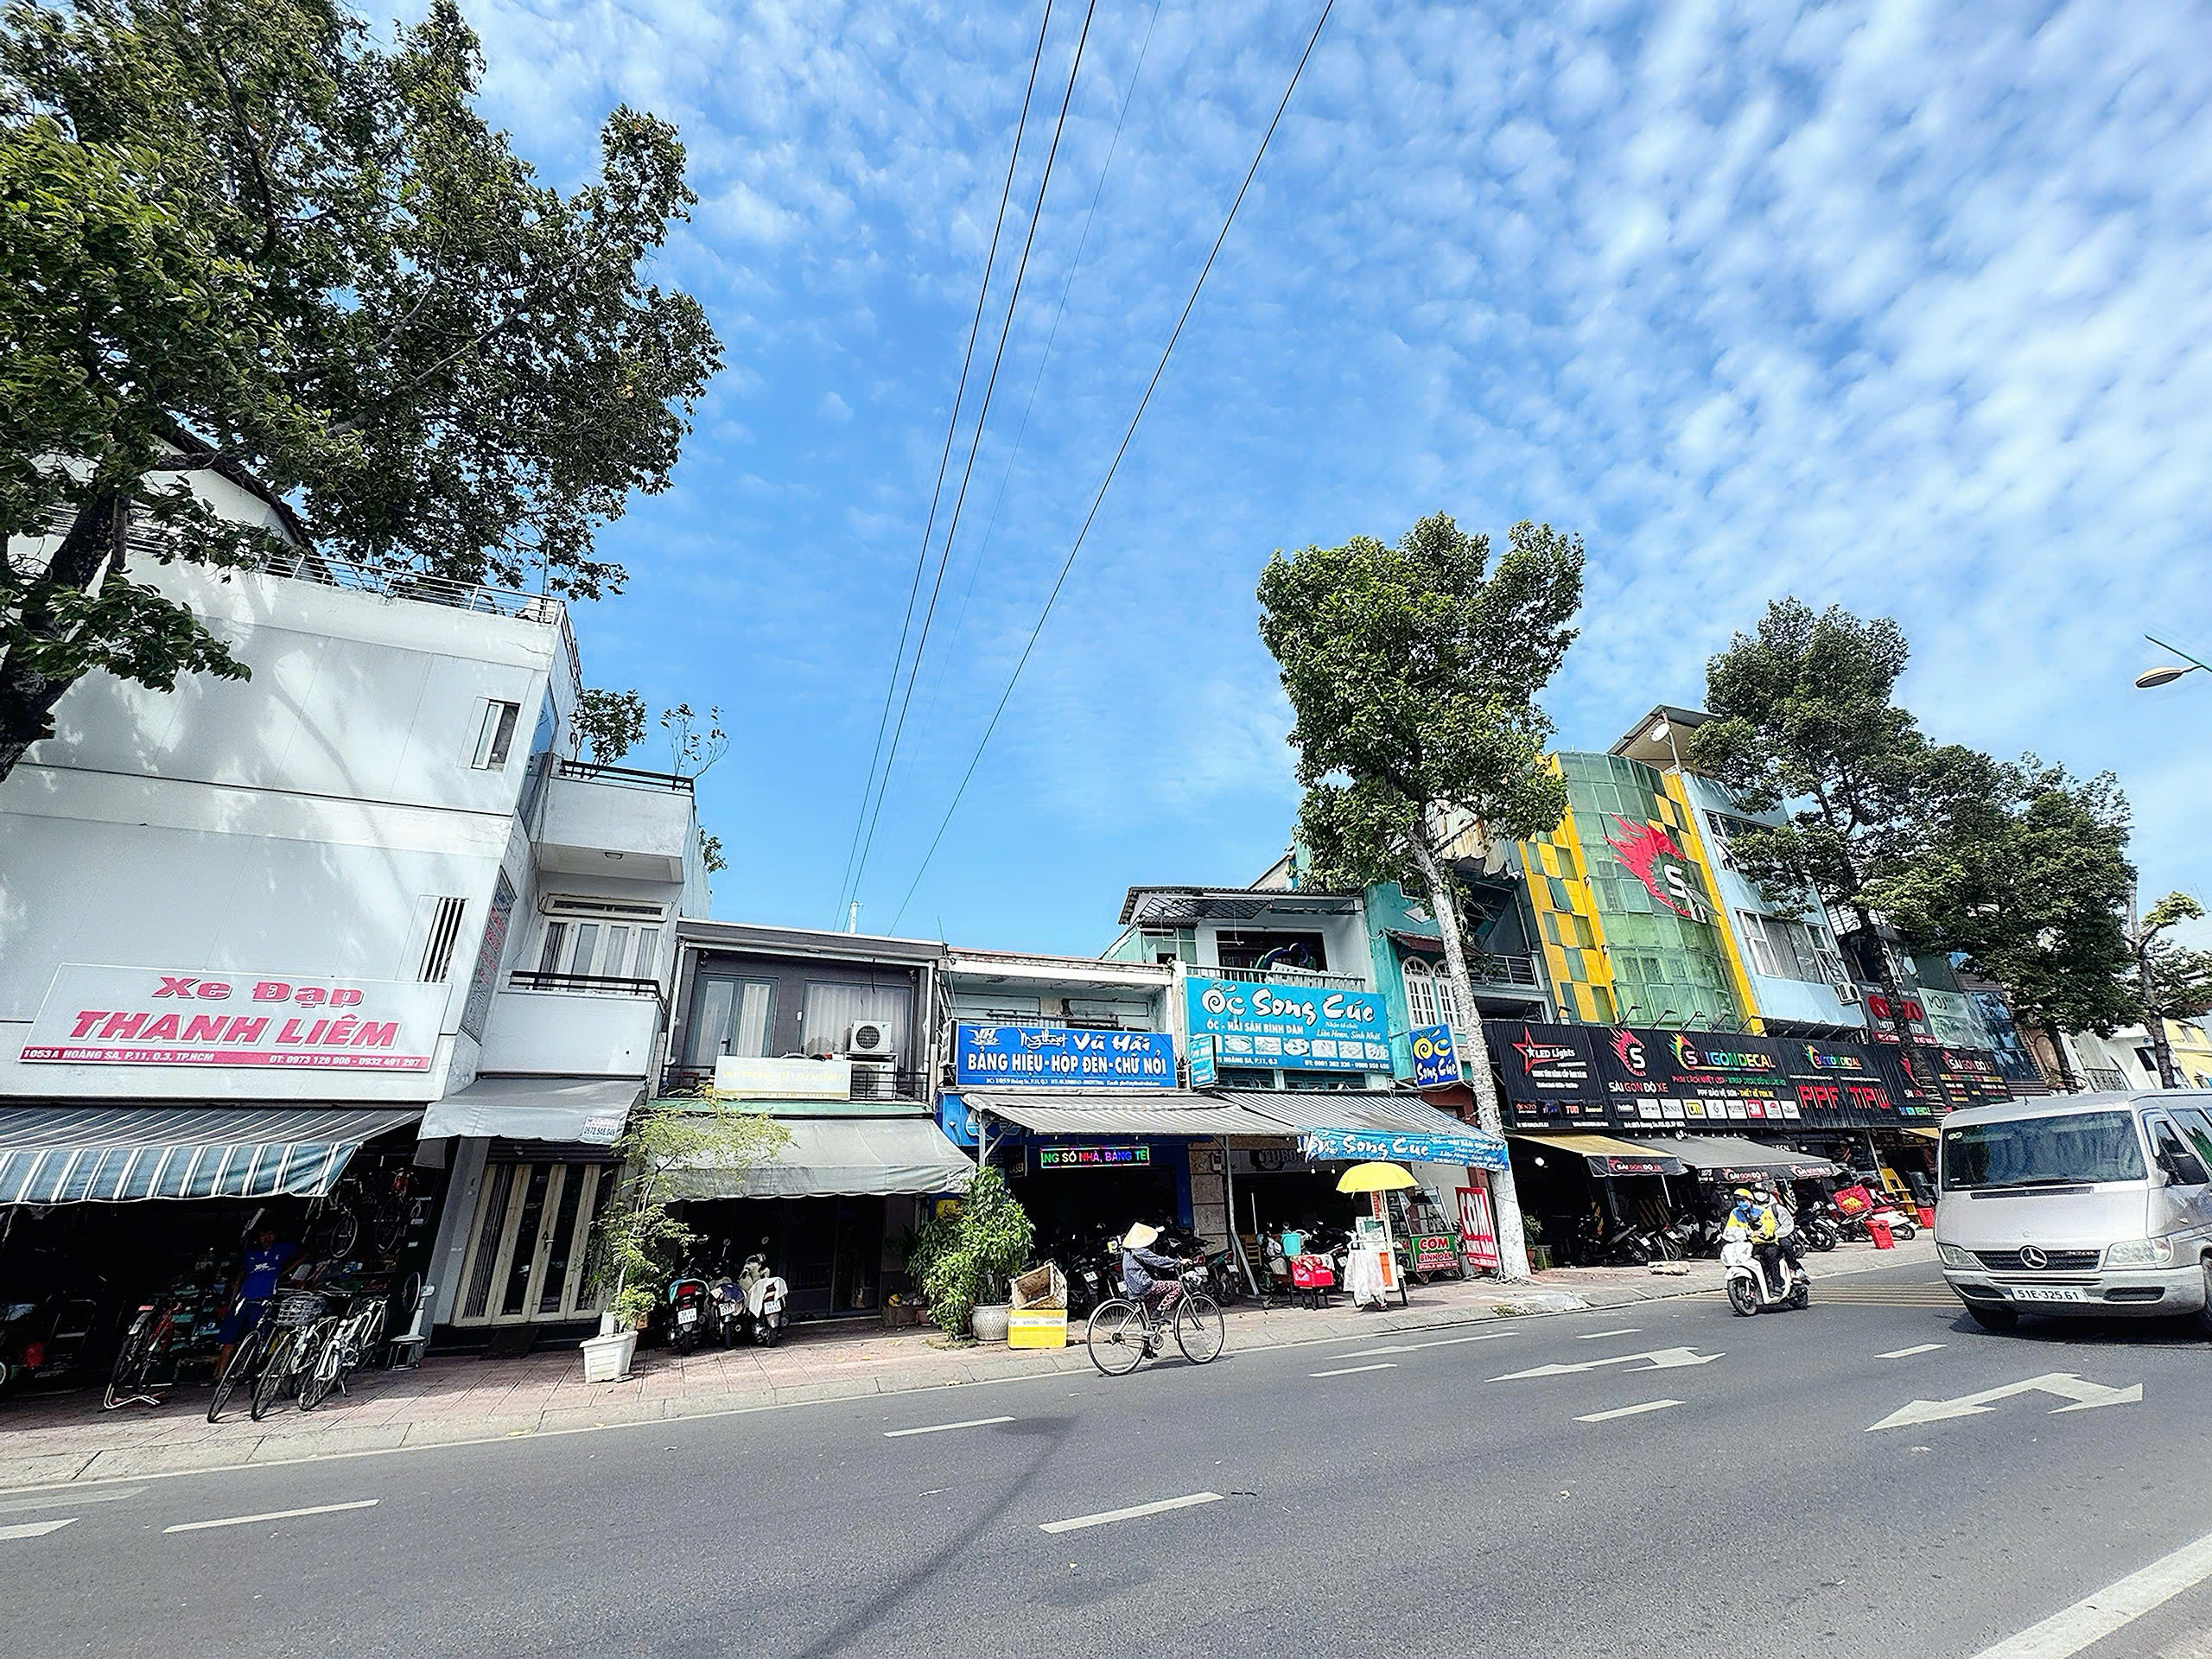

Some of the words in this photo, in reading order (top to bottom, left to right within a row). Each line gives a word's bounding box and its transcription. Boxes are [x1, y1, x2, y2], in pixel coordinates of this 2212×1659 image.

[152, 976, 232, 1001] Xe
[252, 981, 365, 1009] Đạp
[1251, 987, 1318, 1027] Song
[1322, 993, 1376, 1024] Cúc
[69, 1009, 273, 1046] THANH
[275, 1013, 402, 1050] LIÊM
[1264, 1021, 1285, 1034] BÌNH
[1287, 1022, 1304, 1035] DÂN
[1072, 1033, 1105, 1052] Vũ
[1111, 1034, 1151, 1052] Hải
[23, 1049, 60, 1058] 1053A
[62, 1048, 103, 1060] HOÀNG
[287, 1055, 312, 1065] 0973
[359, 1057, 381, 1065] 0932
[968, 1046, 1007, 1071] BẢNG
[1012, 1050, 1043, 1076] HIỆU
[1052, 1052, 1078, 1077] HỘP
[1082, 1052, 1108, 1073] ĐÈN
[1115, 1054, 1140, 1073] CHỮ
[1417, 1062, 1438, 1083] Song
[1438, 1057, 1457, 1077] Cúc
[1656, 1082, 1669, 1093] XE
[1796, 1085, 1840, 1109] PPF
[1061, 1150, 1077, 1163] SỐ
[1078, 1150, 1103, 1164] NHÀ,
[1105, 1148, 1132, 1162] BẢNG
[1342, 1135, 1389, 1160] Song
[1391, 1135, 1430, 1157] Cúc
[1419, 1236, 1450, 1251] CƠM
[1419, 1251, 1439, 1262] BÌNH
